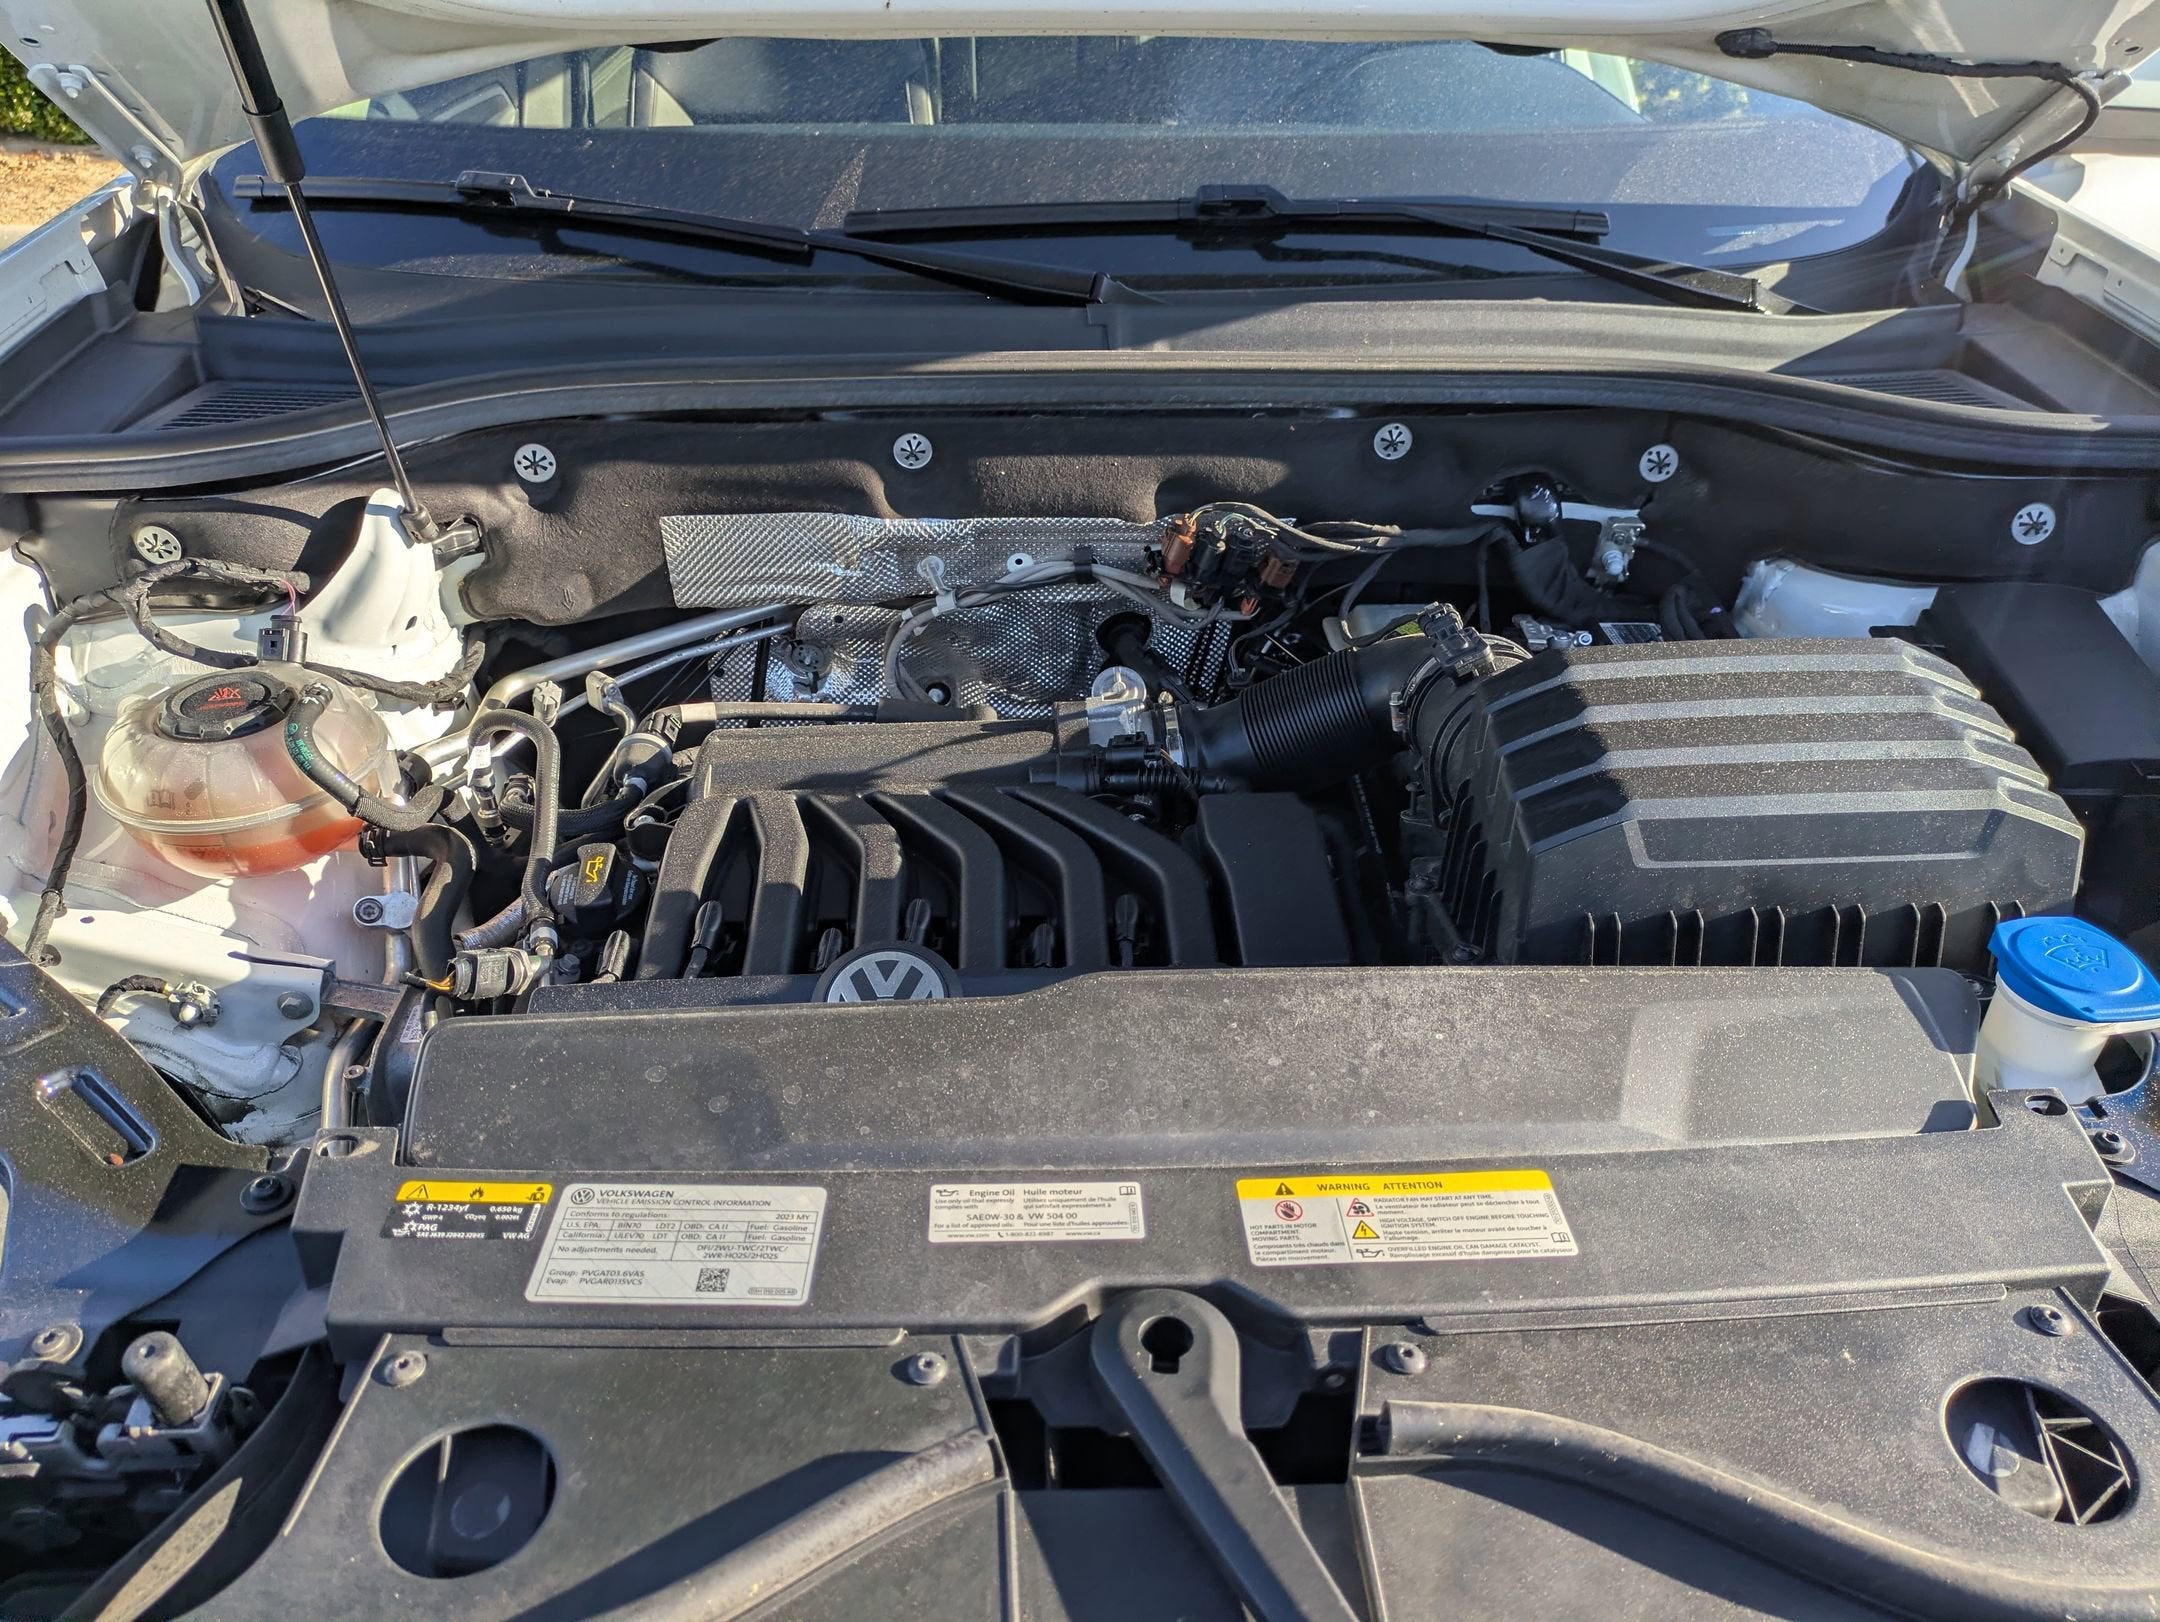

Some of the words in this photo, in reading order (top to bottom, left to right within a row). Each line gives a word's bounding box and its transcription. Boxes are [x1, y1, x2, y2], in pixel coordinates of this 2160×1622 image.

[1317, 1183, 1370, 1191] WARNING
[1383, 1181, 1443, 1190] ATTENTION
[600, 1190, 674, 1198] VOLKSWAGEN
[426, 1204, 470, 1213] R-1234yf
[417, 1223, 438, 1231] PAG
[571, 1246, 623, 1254] adjustments
